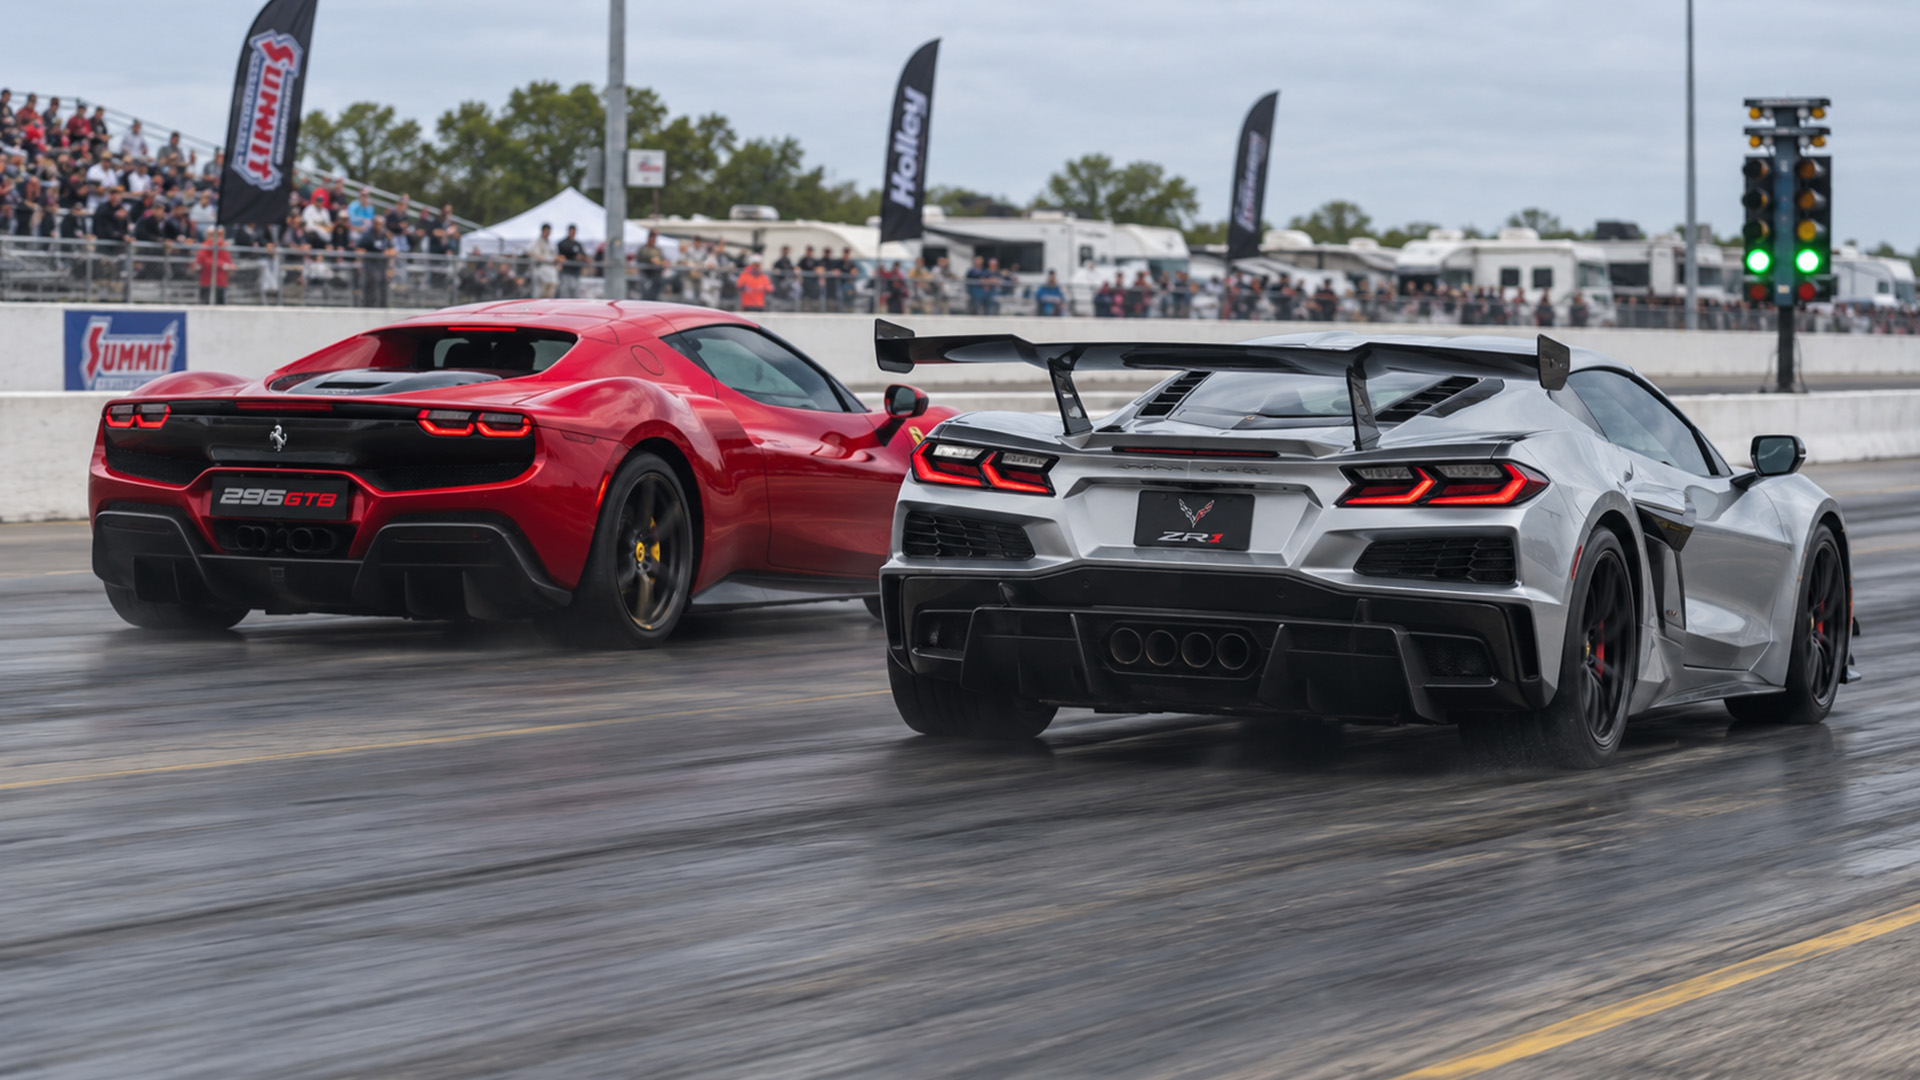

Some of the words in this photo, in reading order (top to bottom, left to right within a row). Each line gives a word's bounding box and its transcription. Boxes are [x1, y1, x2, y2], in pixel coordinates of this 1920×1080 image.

[248, 39, 295, 180] SUMMIT
[889, 84, 928, 210] Holley
[86, 326, 173, 381] SUMMIT
[1157, 530, 1224, 544] ZR1
